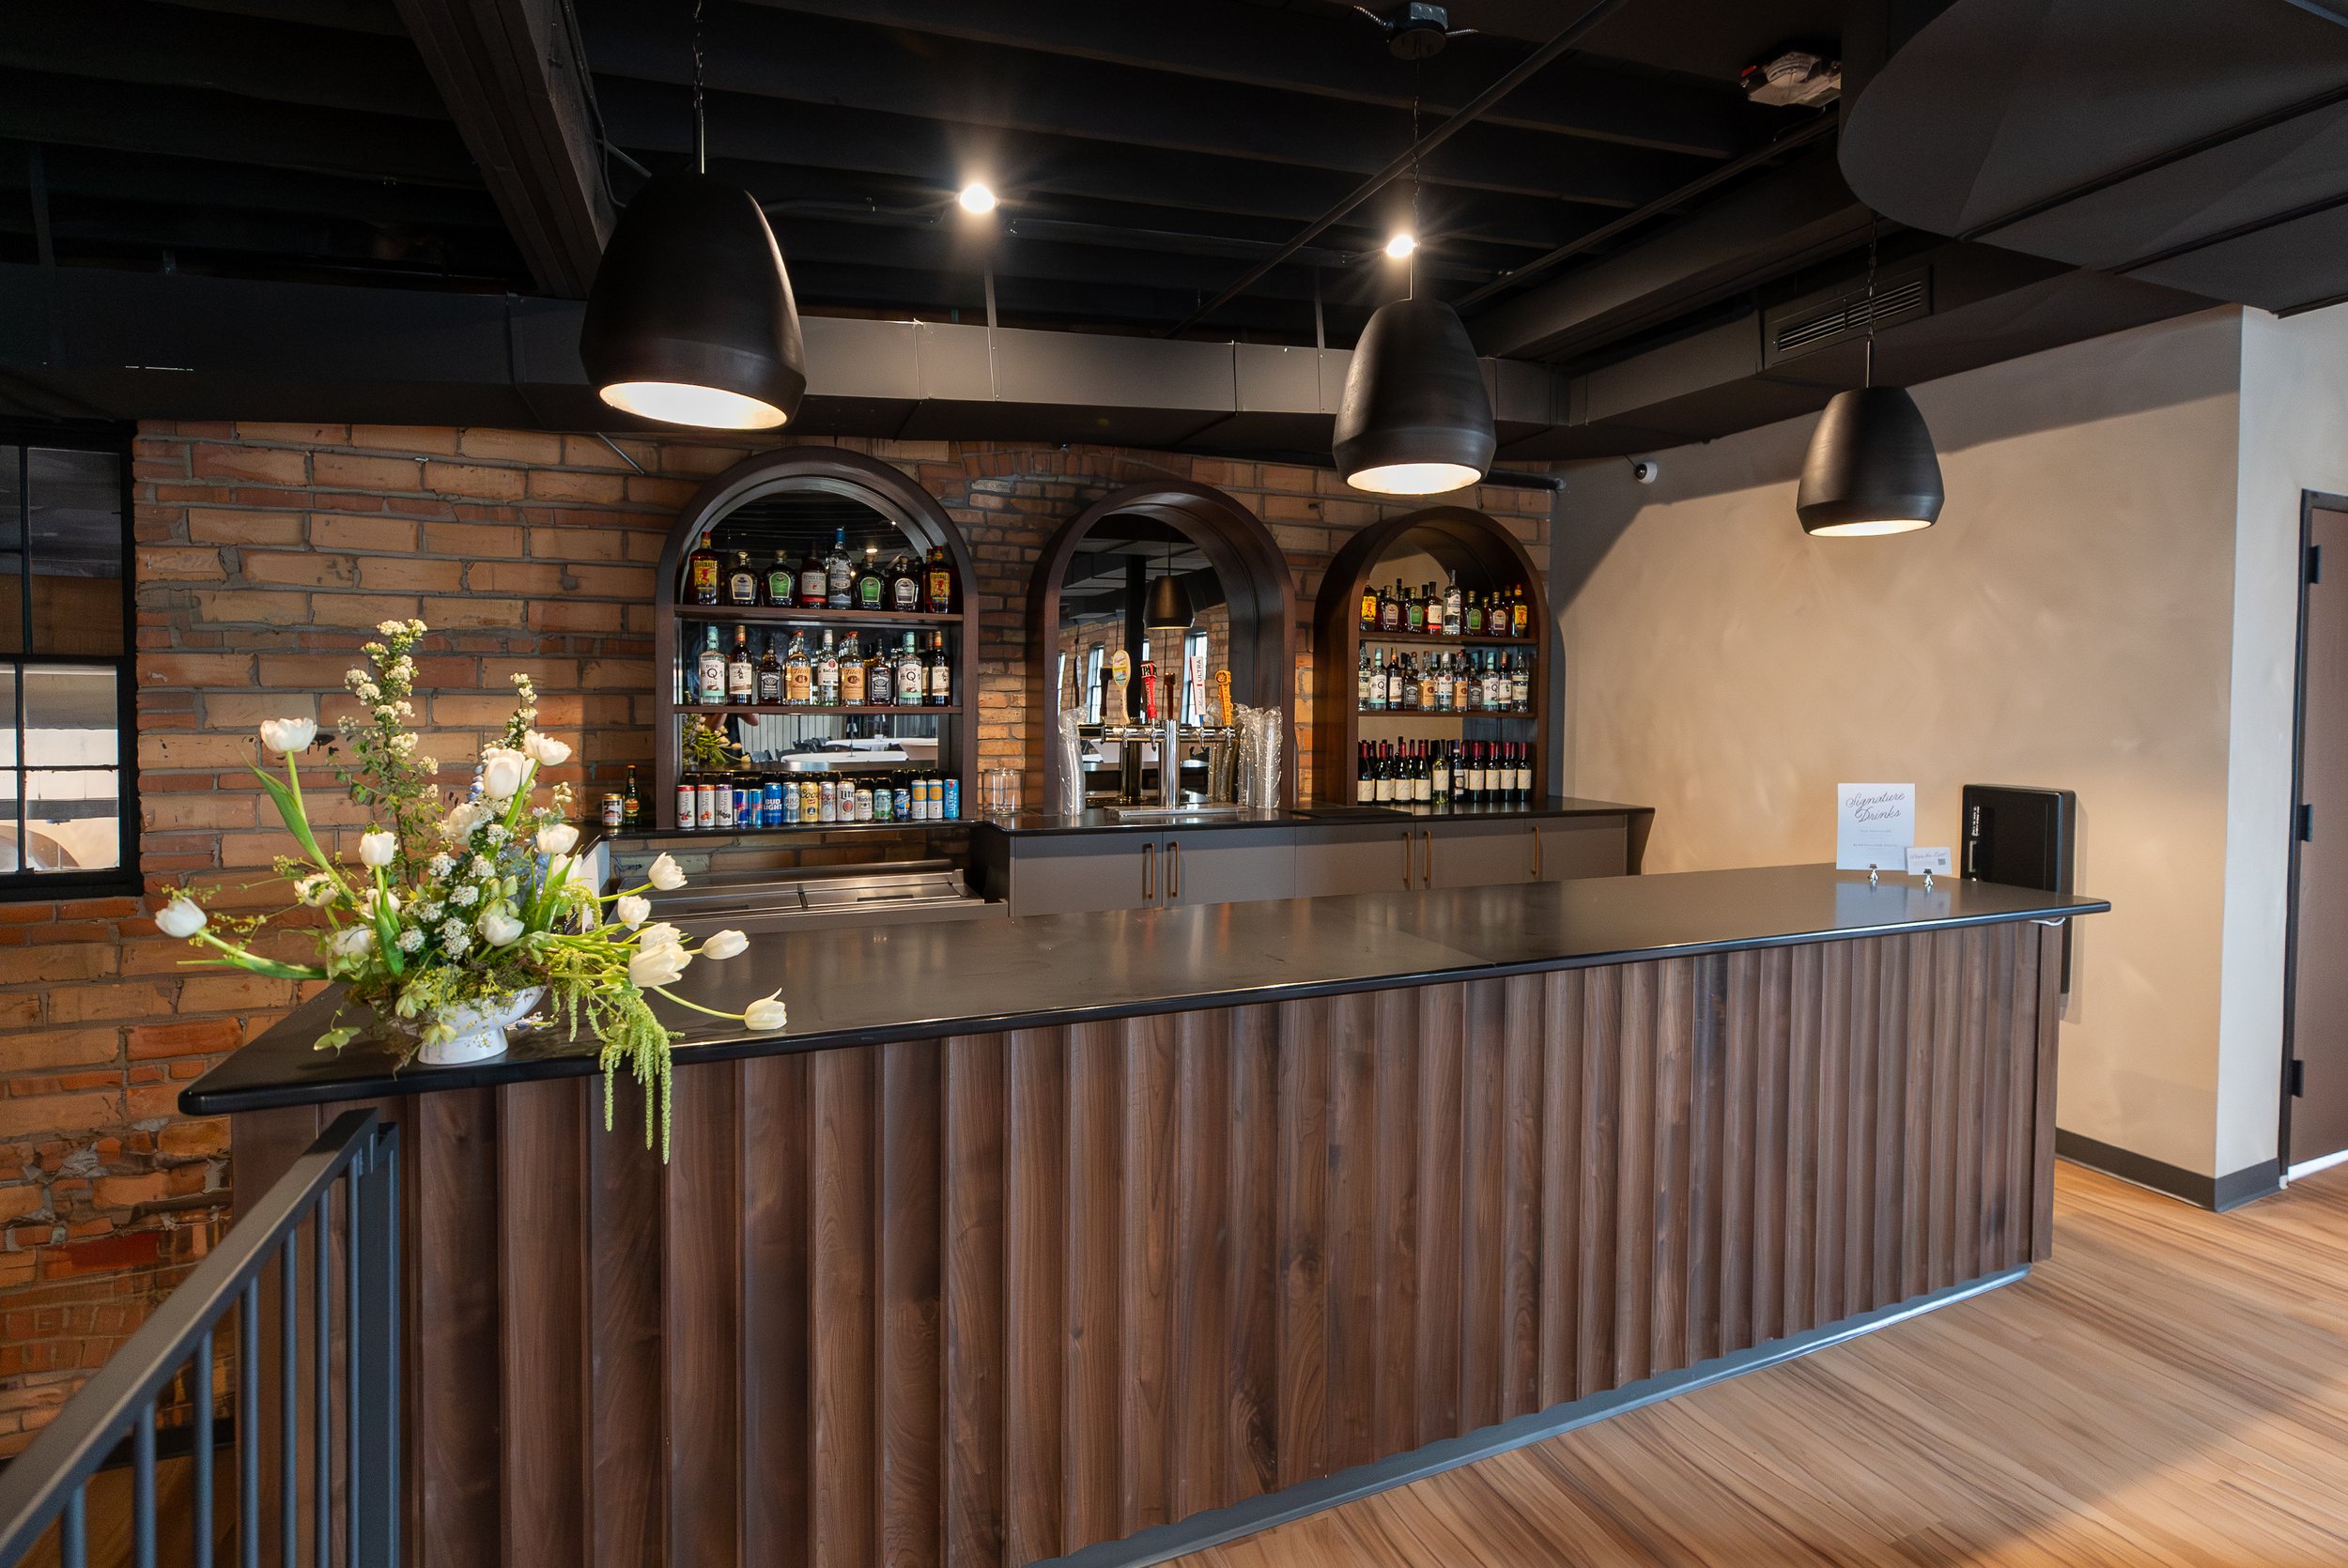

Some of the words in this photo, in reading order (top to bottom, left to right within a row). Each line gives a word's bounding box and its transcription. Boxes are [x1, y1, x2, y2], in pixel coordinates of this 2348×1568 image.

[707, 668, 718, 680] Q
[906, 671, 916, 683] Q
[1846, 792, 1906, 808] Signature
[1854, 806, 1902, 822] Drinks
